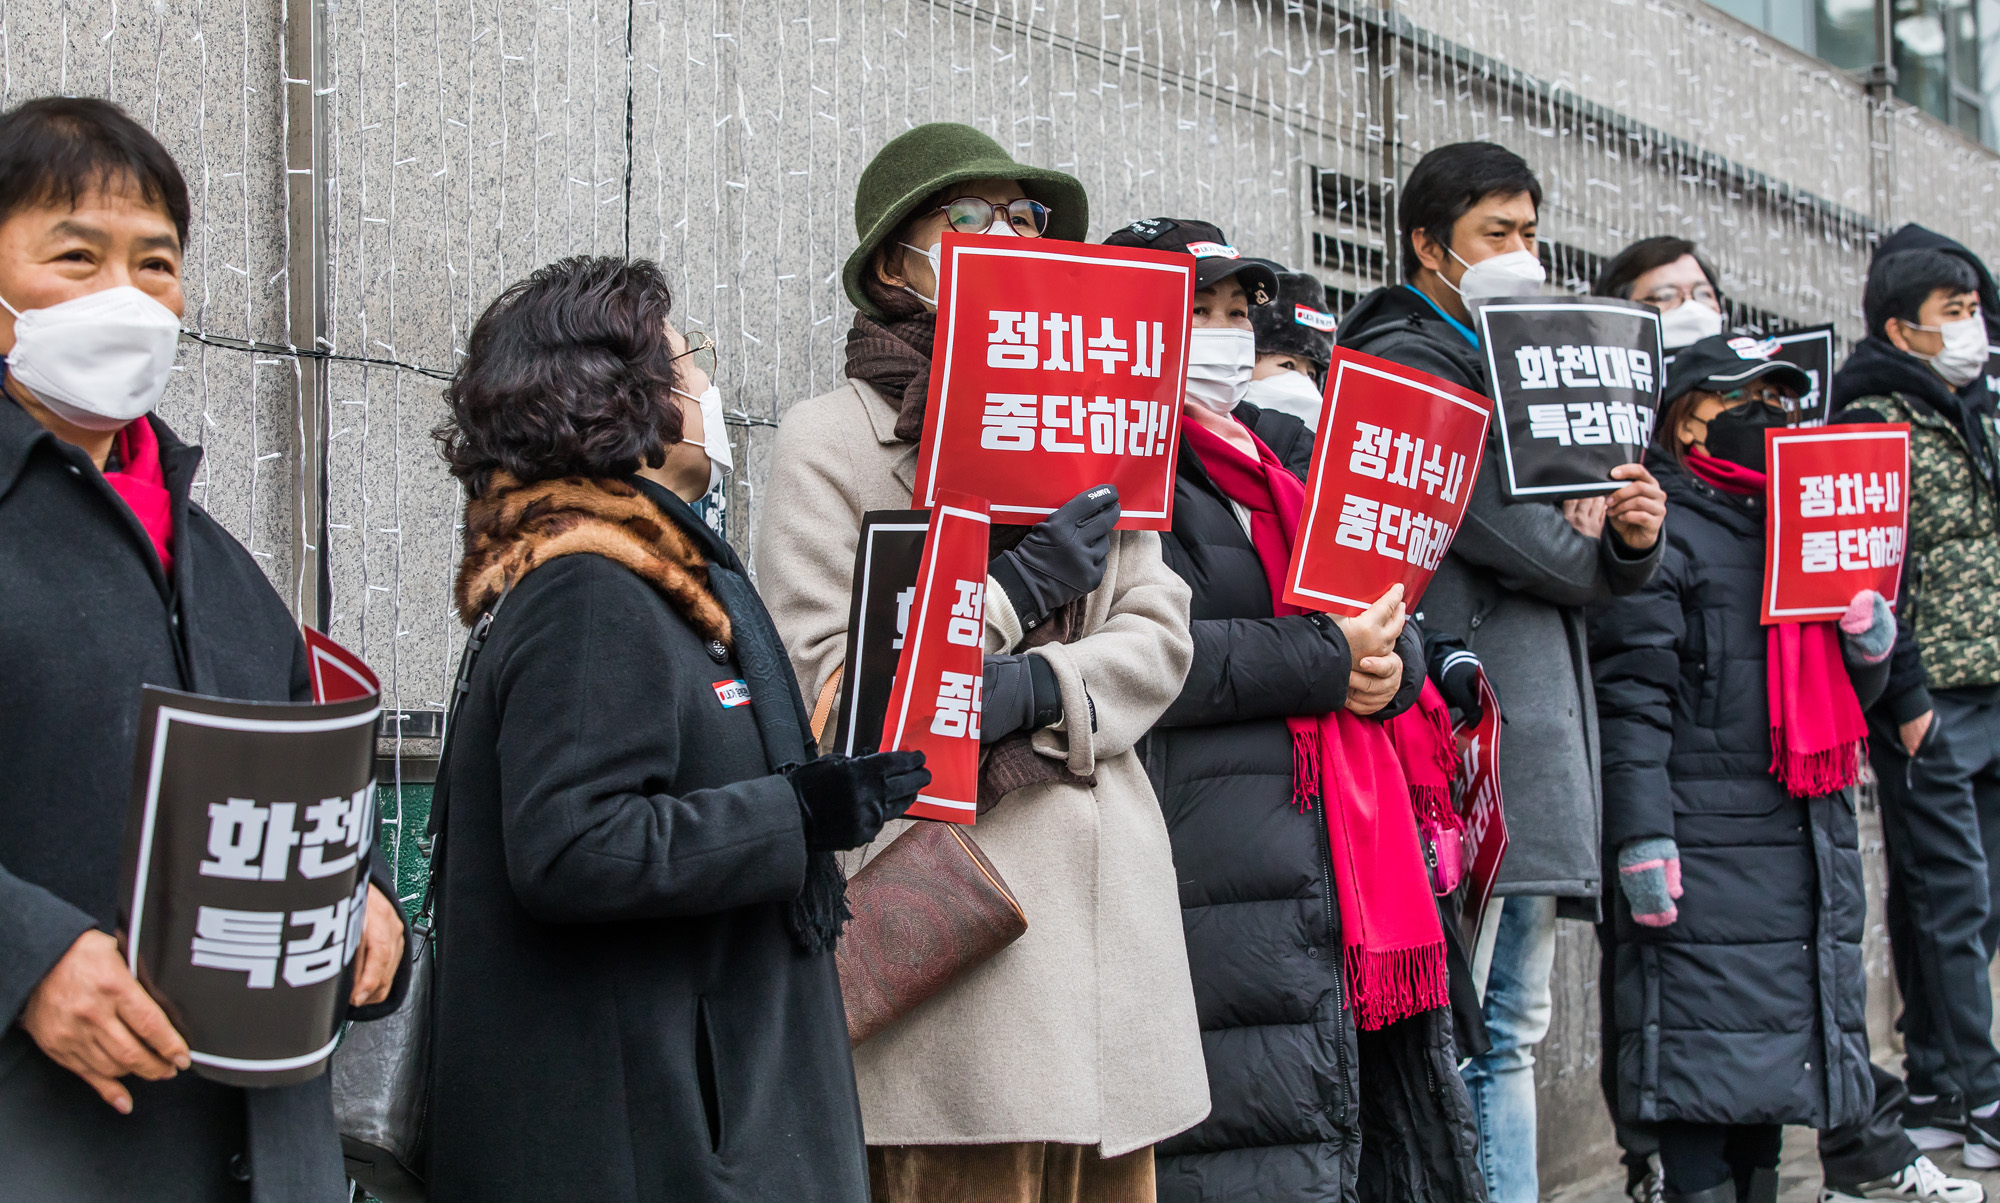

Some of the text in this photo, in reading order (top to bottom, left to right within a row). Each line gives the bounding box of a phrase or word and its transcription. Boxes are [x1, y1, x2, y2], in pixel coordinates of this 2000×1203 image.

[985, 309, 1166, 379] 정치수사
[1514, 344, 1654, 394] 화천대유
[980, 391, 1171, 457] 중단하라!
[1348, 420, 1467, 505] 정치수사
[1799, 470, 1901, 519] 정치수사
[1334, 492, 1454, 572] 중단하라!
[1800, 525, 1903, 574] 중단하라!
